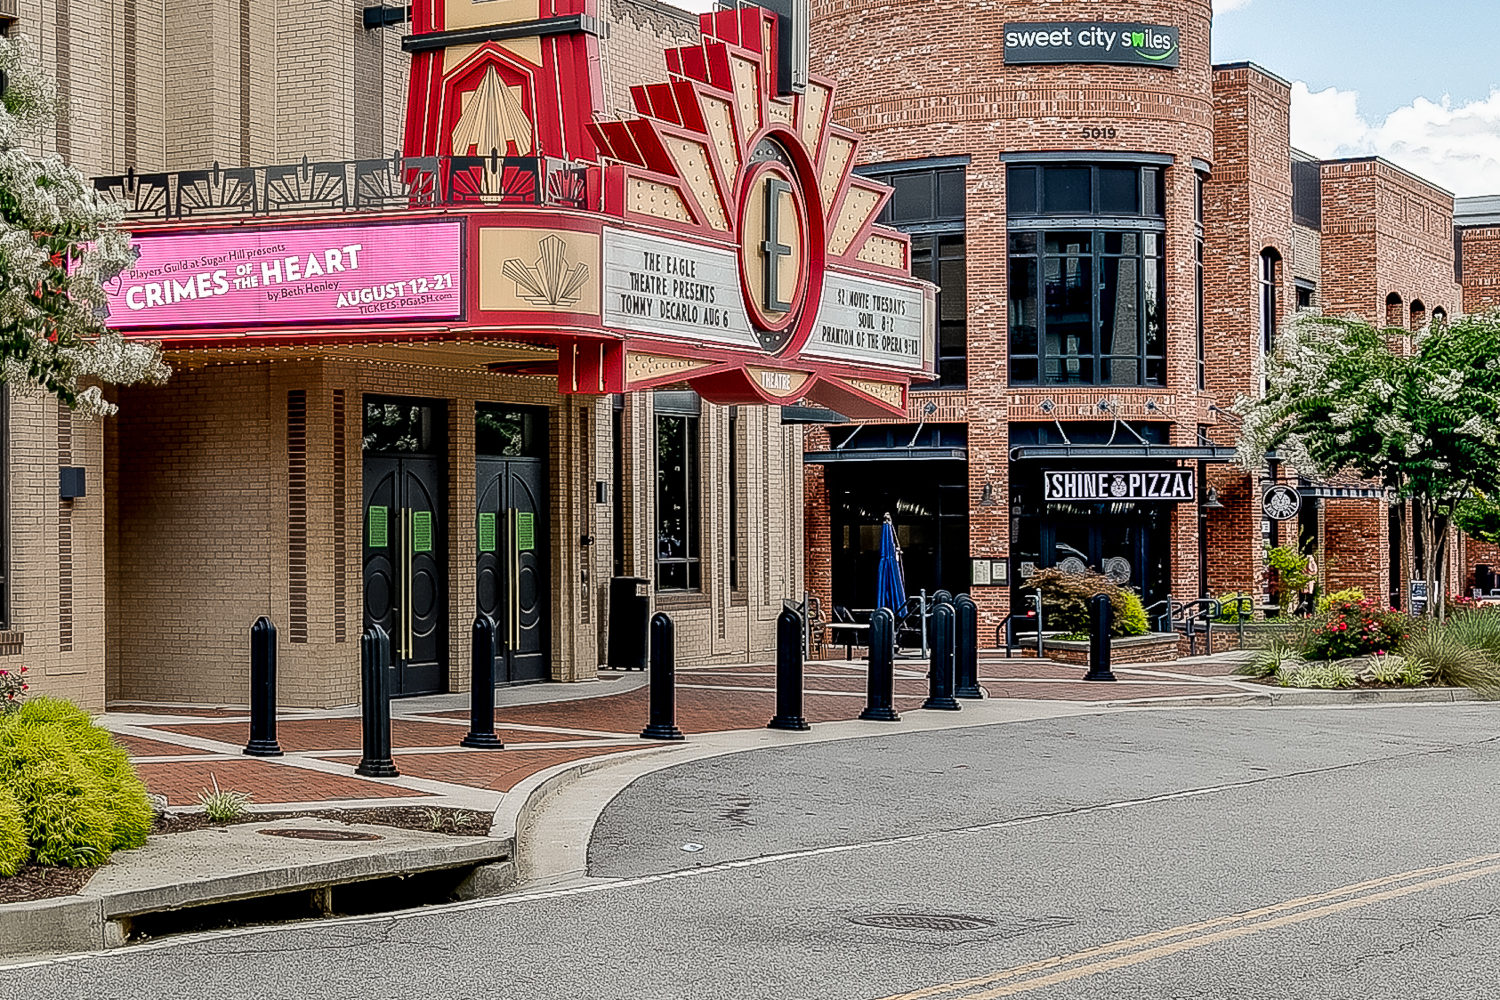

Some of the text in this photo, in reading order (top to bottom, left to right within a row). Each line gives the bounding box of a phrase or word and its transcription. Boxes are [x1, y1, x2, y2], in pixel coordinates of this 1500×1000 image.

[1005, 26, 1171, 51] sweet city smiles
[1082, 127, 1116, 139] 5019
[128, 243, 286, 280] Players Guild at Sugar Hill presents
[643, 251, 696, 279] THE EAGLE
[125, 244, 363, 311] CRIMES OF THE HEART
[266, 280, 340, 302] by Beth Henley
[336, 273, 453, 309] AUGUST 12-21
[629, 271, 715, 304] THEATRE PRESENTS
[359, 293, 453, 315] TICKETS: PGatSH.com
[620, 293, 729, 328] TOMMY DECARLO AUG 6
[837, 288, 906, 316] $2 MOVIE TUESDAYS
[858, 312, 875, 330] SOUL
[822, 325, 854, 347] PHANTOM
[856, 331, 865, 348] OF
[867, 333, 879, 350] THE
[881, 335, 903, 354] OPERA
[761, 371, 791, 391] THEATRE
[1051, 473, 1186, 498] SHINE PIZZA
